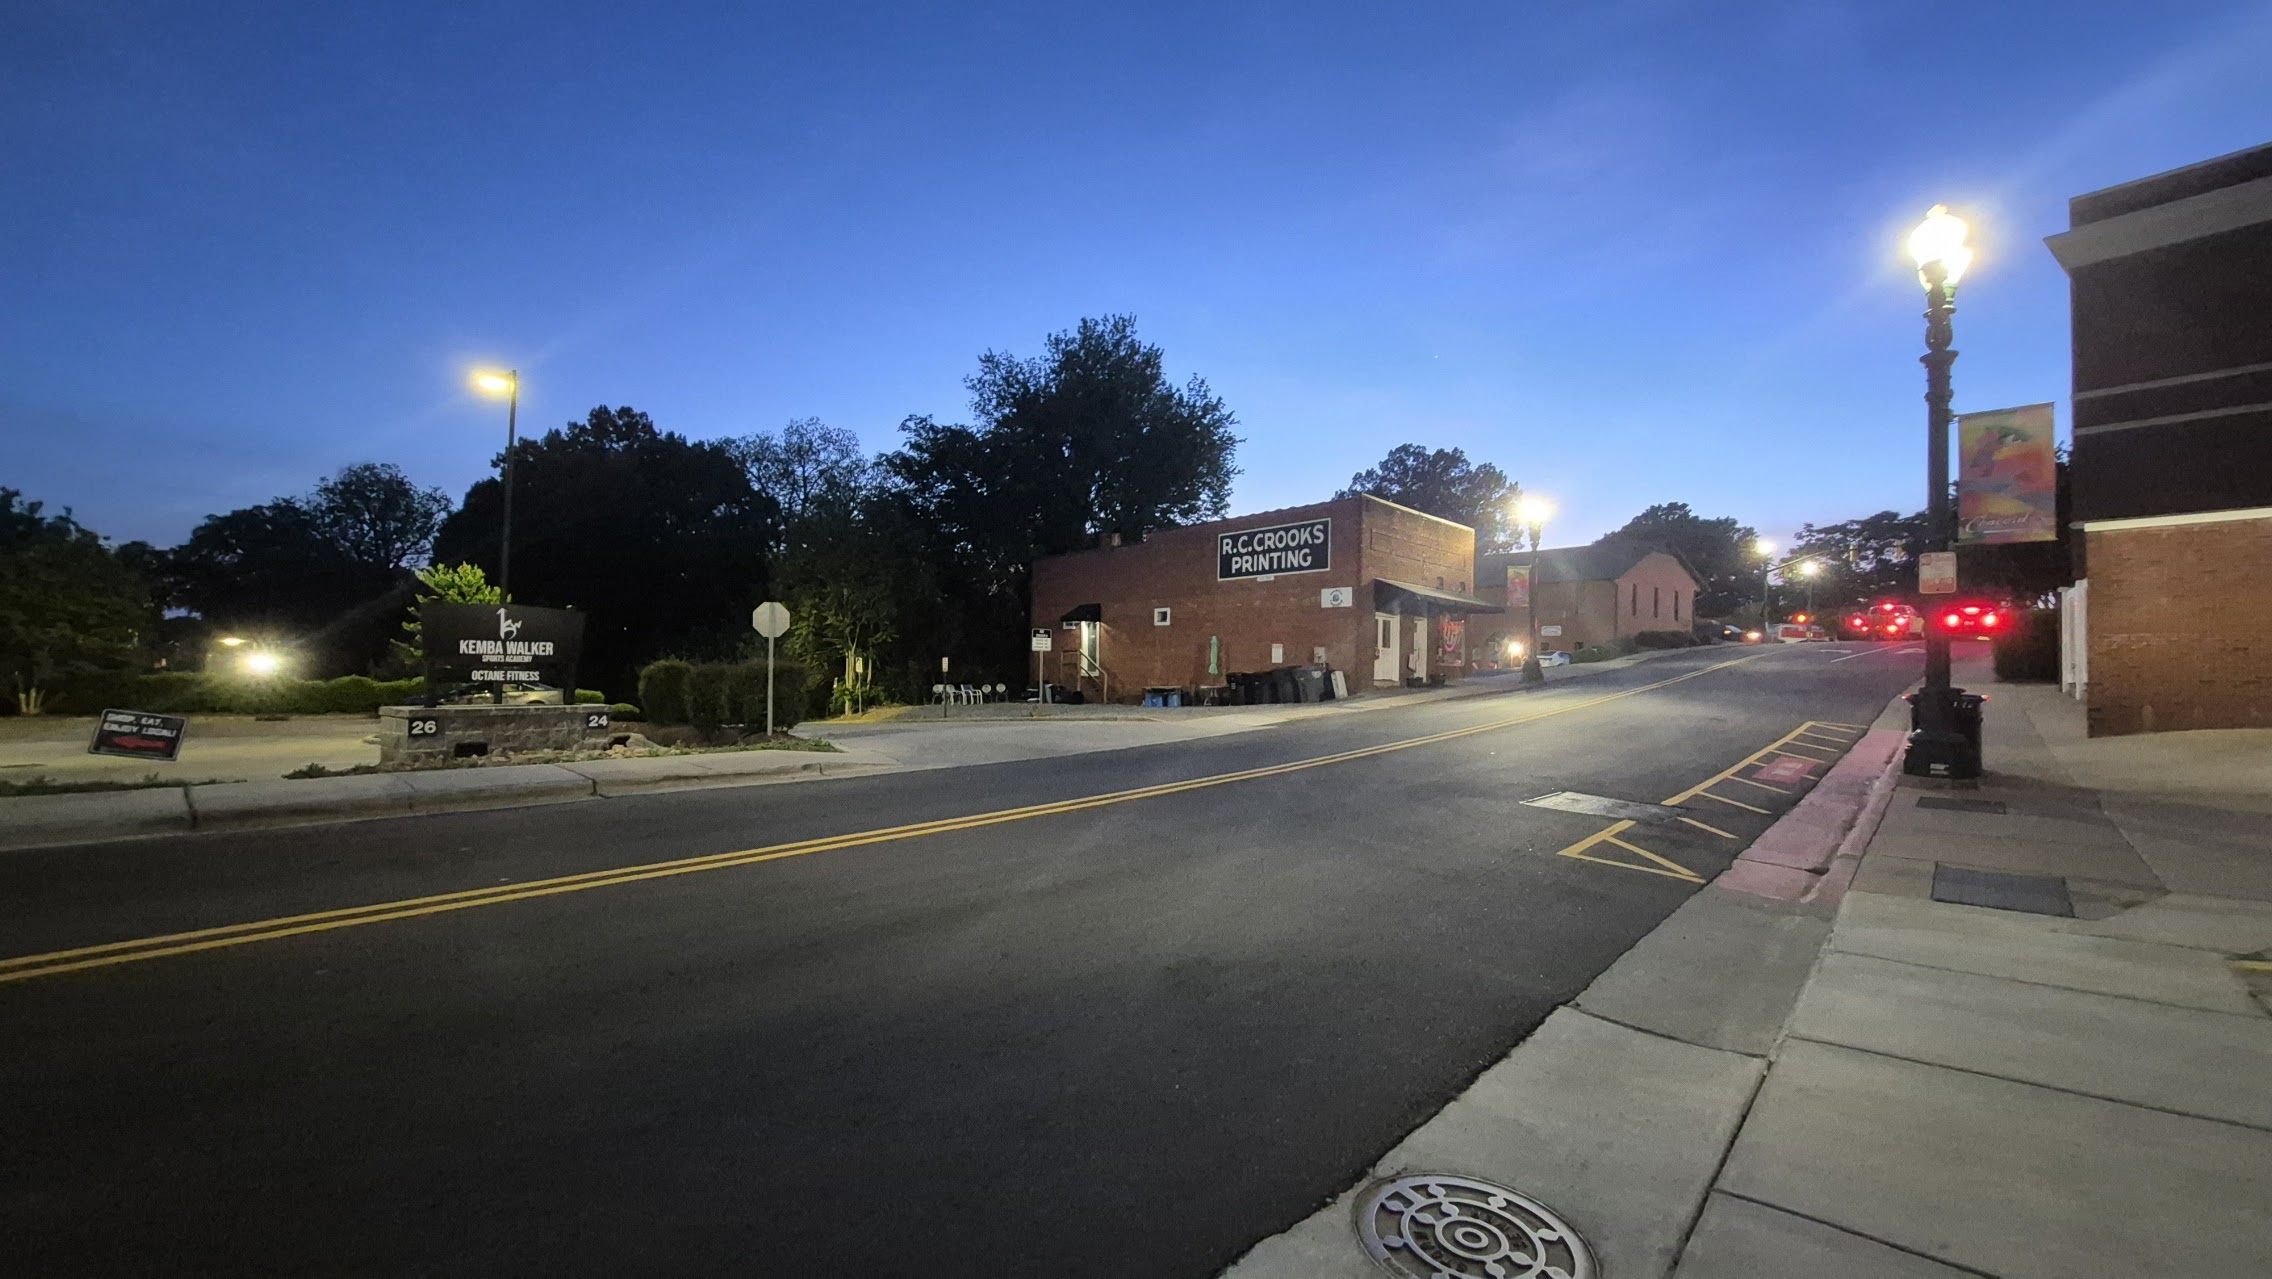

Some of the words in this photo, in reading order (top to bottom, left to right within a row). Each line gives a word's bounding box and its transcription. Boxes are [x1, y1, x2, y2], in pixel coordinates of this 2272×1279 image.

[1231, 548, 1312, 574] PRINTING
[459, 639, 504, 655] KEMBA
[506, 641, 554, 656] WALKER
[482, 654, 505, 663] SPORTS
[505, 655, 533, 663] ACADEMY
[471, 670, 506, 681] OCTANE
[506, 671, 540, 681] FITNESS
[411, 720, 437, 735] 26
[588, 715, 608, 728] 24
